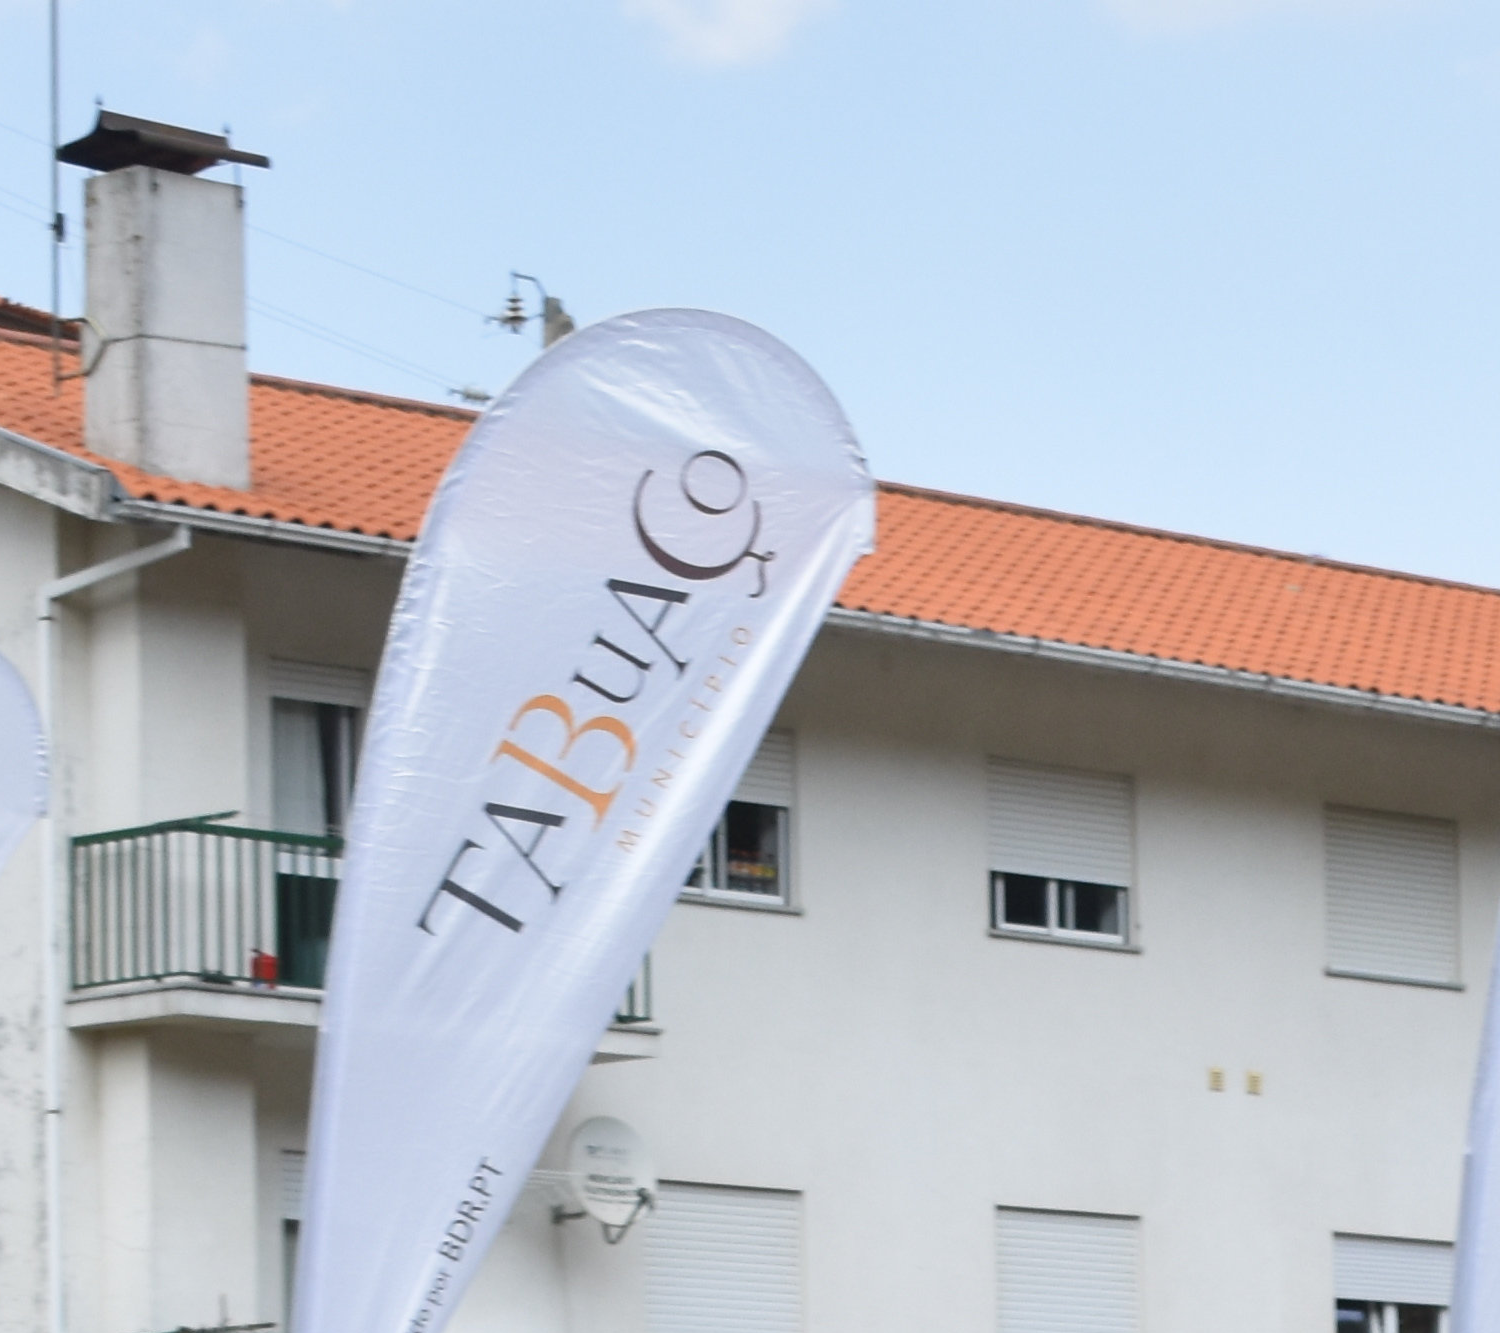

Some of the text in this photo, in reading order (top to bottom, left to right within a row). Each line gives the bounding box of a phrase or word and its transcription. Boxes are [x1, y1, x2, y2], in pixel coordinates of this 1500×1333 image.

[416, 450, 776, 936] TABUAÇO
[437, 1156, 504, 1262] BDR.PT
[427, 1271, 453, 1306] por
